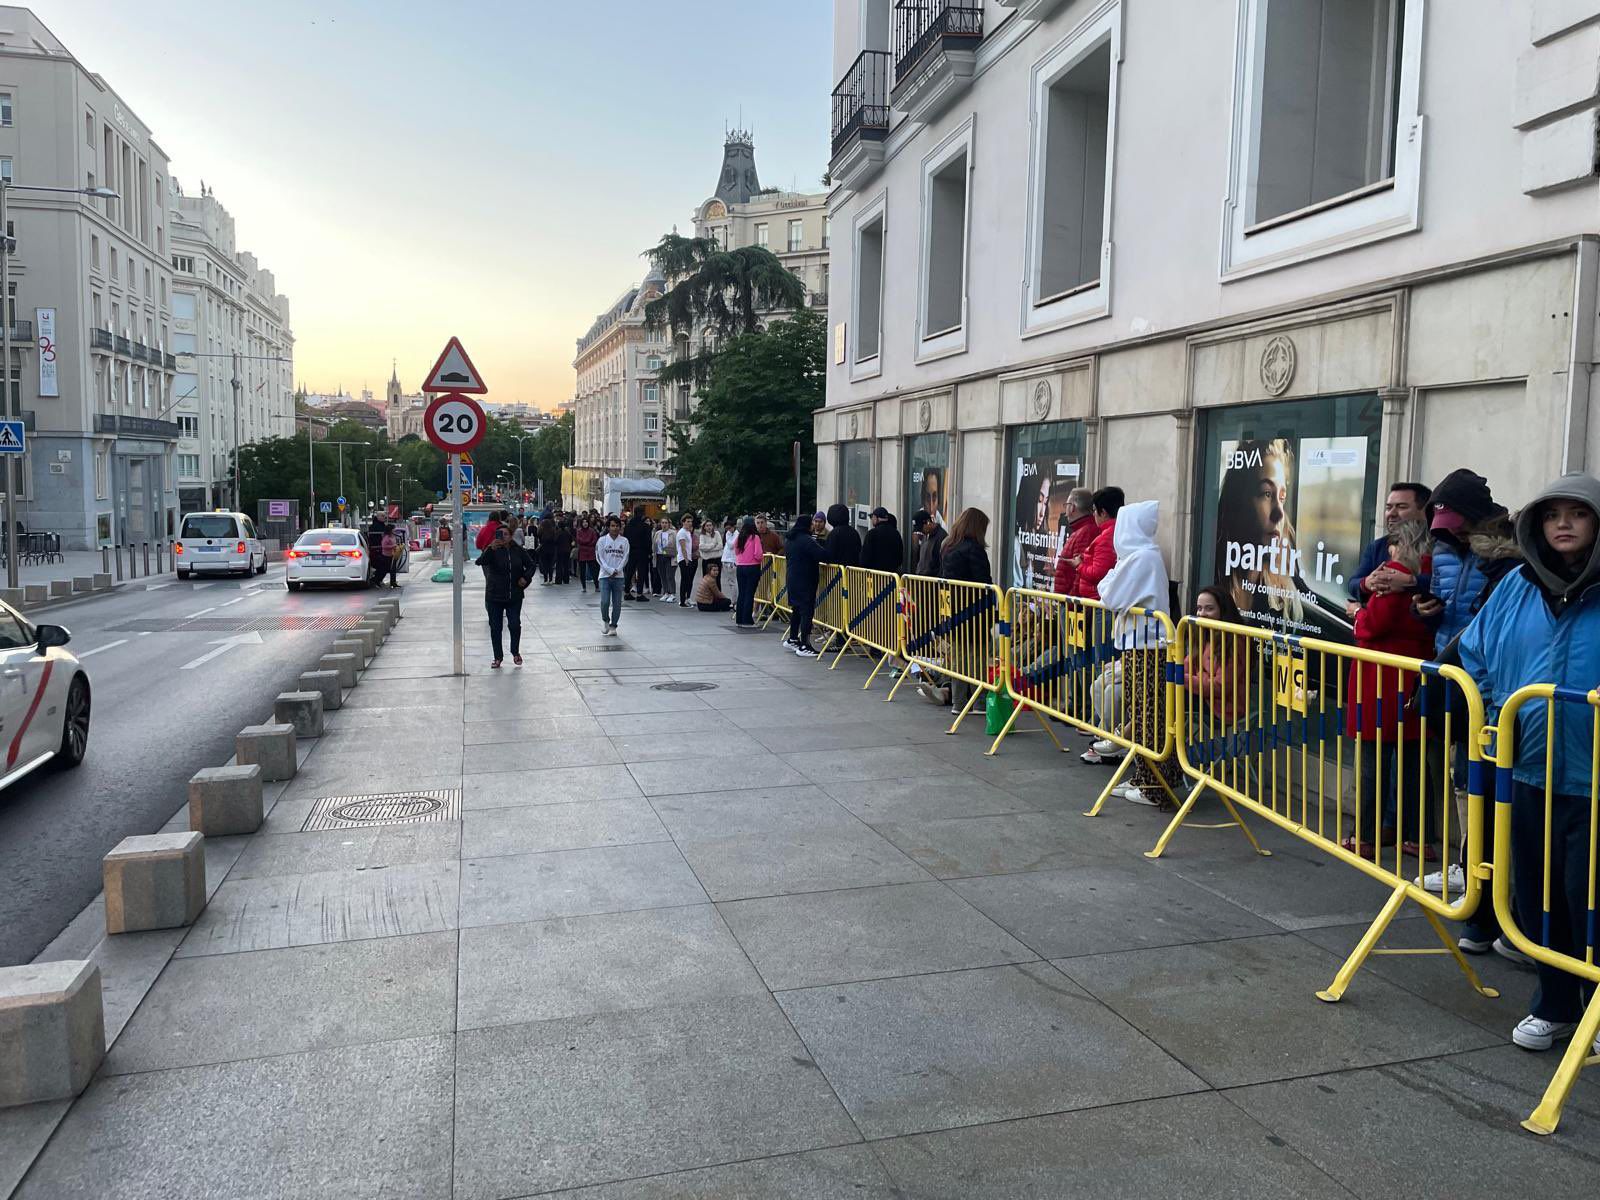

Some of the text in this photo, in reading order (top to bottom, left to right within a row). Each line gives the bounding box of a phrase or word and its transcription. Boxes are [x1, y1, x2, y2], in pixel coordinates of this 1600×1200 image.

[39, 336, 56, 362] 95
[438, 414, 473, 433] 20
[1021, 462, 1038, 477] BVA
[1226, 447, 1263, 469] BBVA
[1018, 526, 1060, 548] transmiti
[1225, 537, 1344, 584] partir. ir.
[1241, 578, 1319, 605] Hoy comienza todo.
[1256, 611, 1275, 624] Online
[1286, 619, 1322, 635] comisiones
